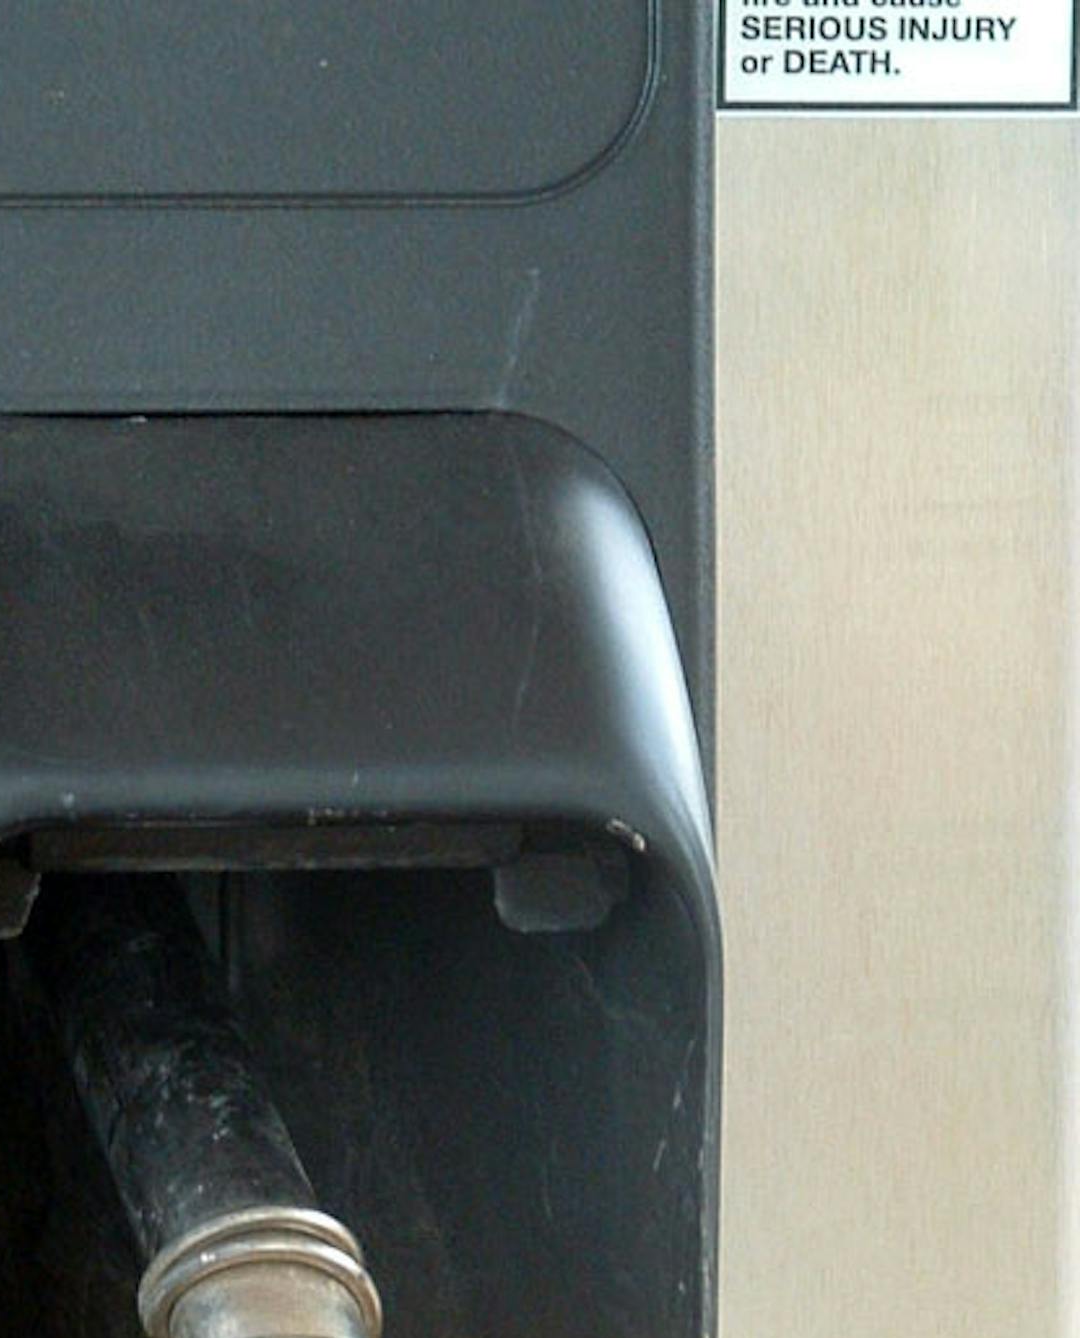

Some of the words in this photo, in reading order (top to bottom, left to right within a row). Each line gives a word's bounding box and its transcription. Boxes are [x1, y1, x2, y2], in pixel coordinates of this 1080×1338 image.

[740, 15, 888, 41] SERIOUS
[899, 16, 1016, 41] INJURY
[741, 54, 774, 74] or
[783, 49, 902, 75] DEATH.
